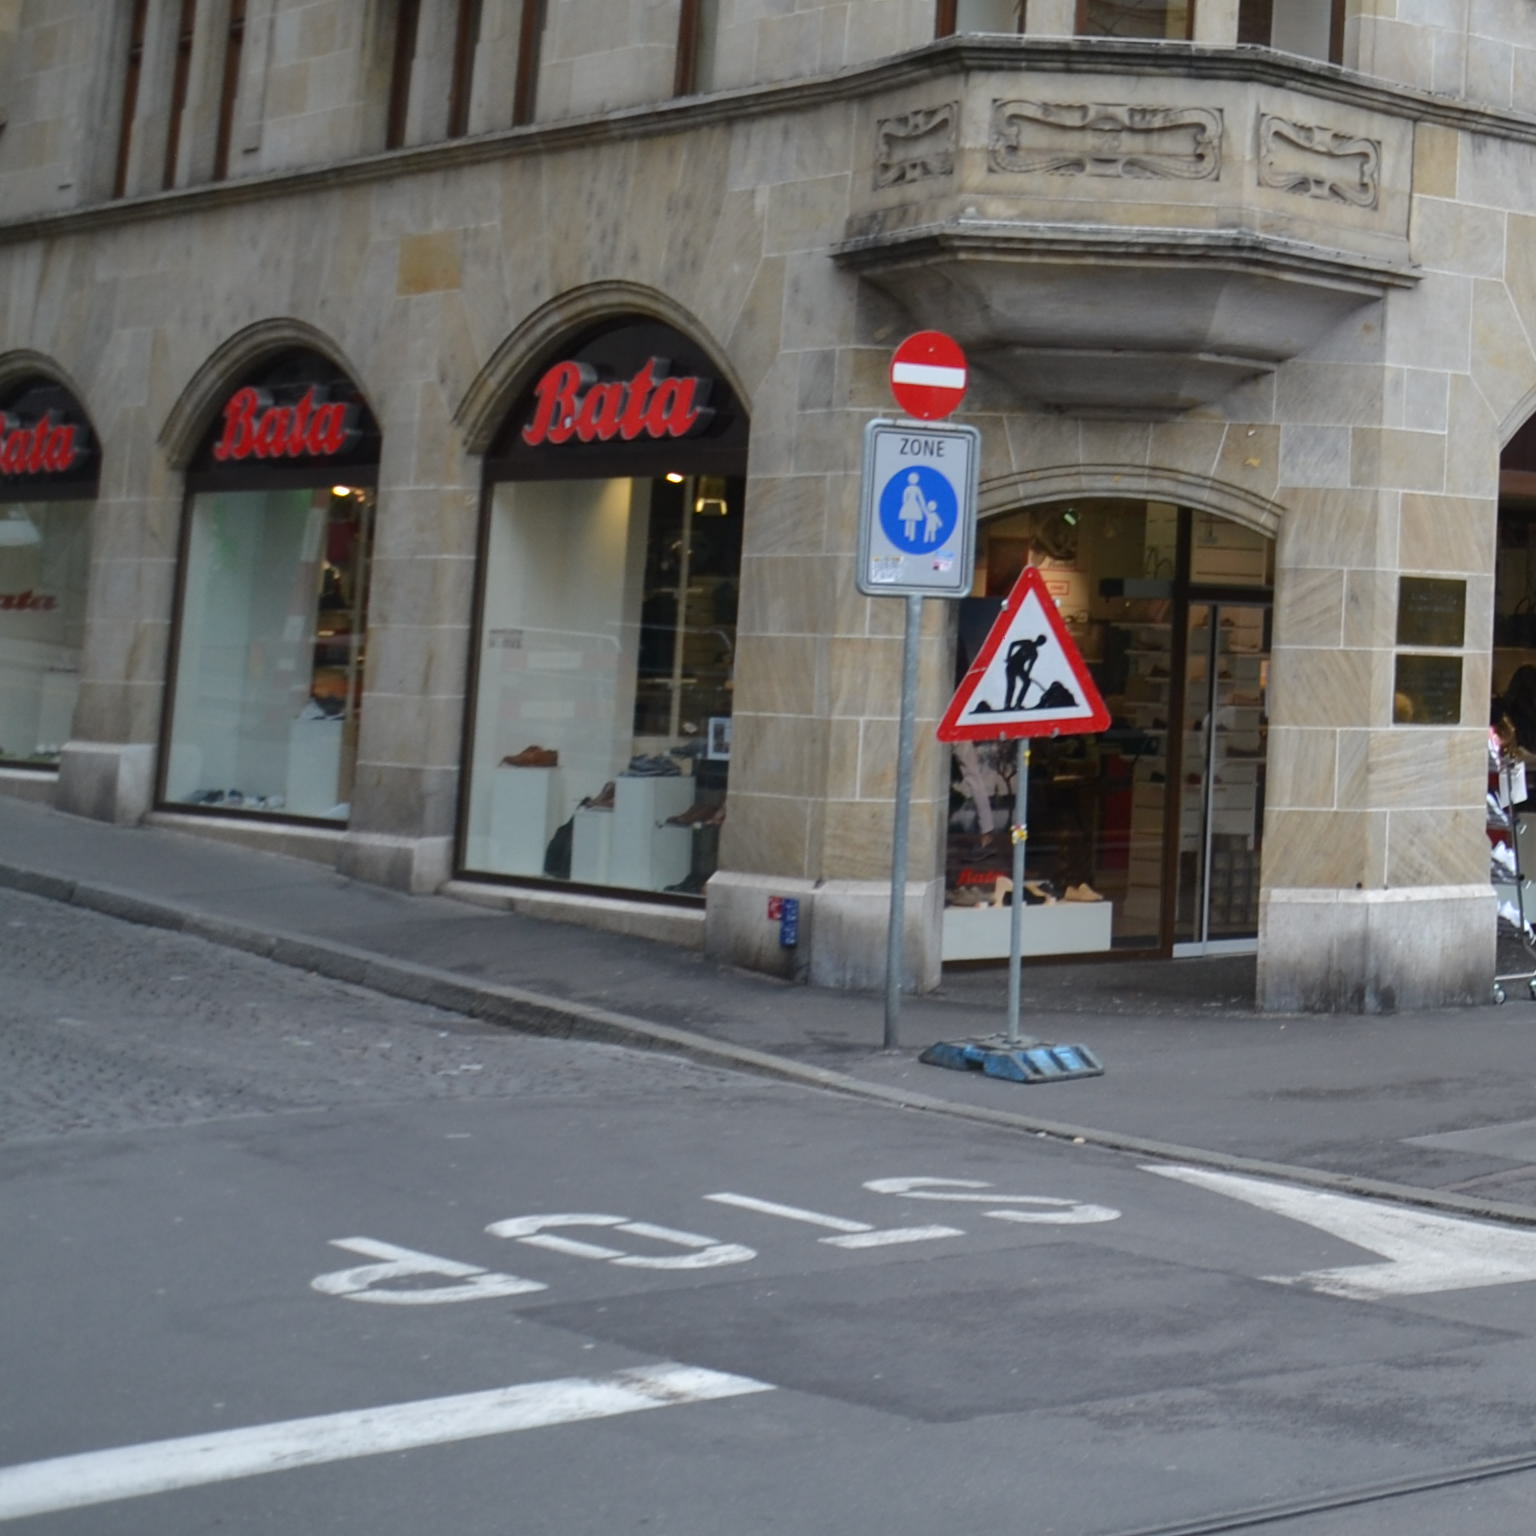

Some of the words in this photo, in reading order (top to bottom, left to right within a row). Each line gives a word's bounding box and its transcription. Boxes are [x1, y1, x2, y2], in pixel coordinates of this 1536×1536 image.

[214, 386, 349, 461] Bata
[522, 356, 700, 447] Bata
[899, 437, 945, 458] ZONE
[0, 590, 58, 611] ata
[308, 1174, 1123, 1305] STOP
